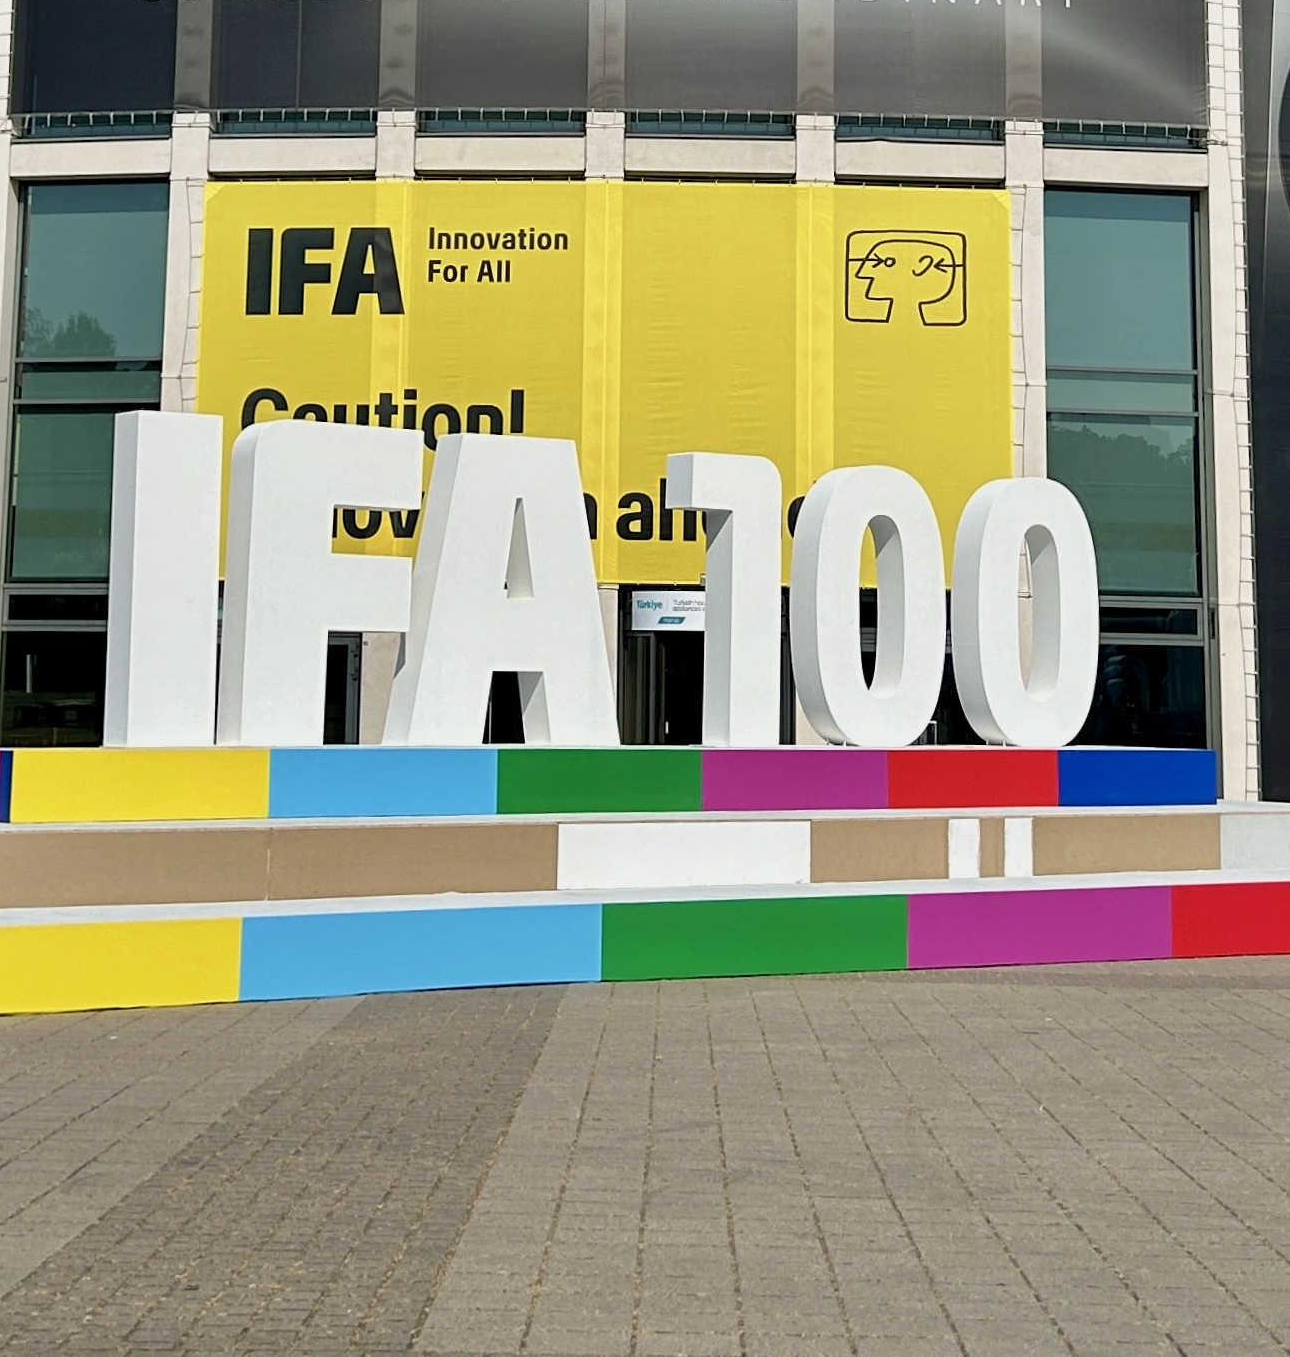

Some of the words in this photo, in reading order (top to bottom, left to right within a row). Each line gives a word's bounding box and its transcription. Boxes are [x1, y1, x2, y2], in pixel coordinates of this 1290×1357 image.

[428, 227, 568, 250] Innovation
[245, 227, 405, 315] IFA
[427, 260, 469, 282] For
[476, 260, 511, 282] All
[107, 411, 621, 747] IFA
[667, 451, 1099, 747] 100
